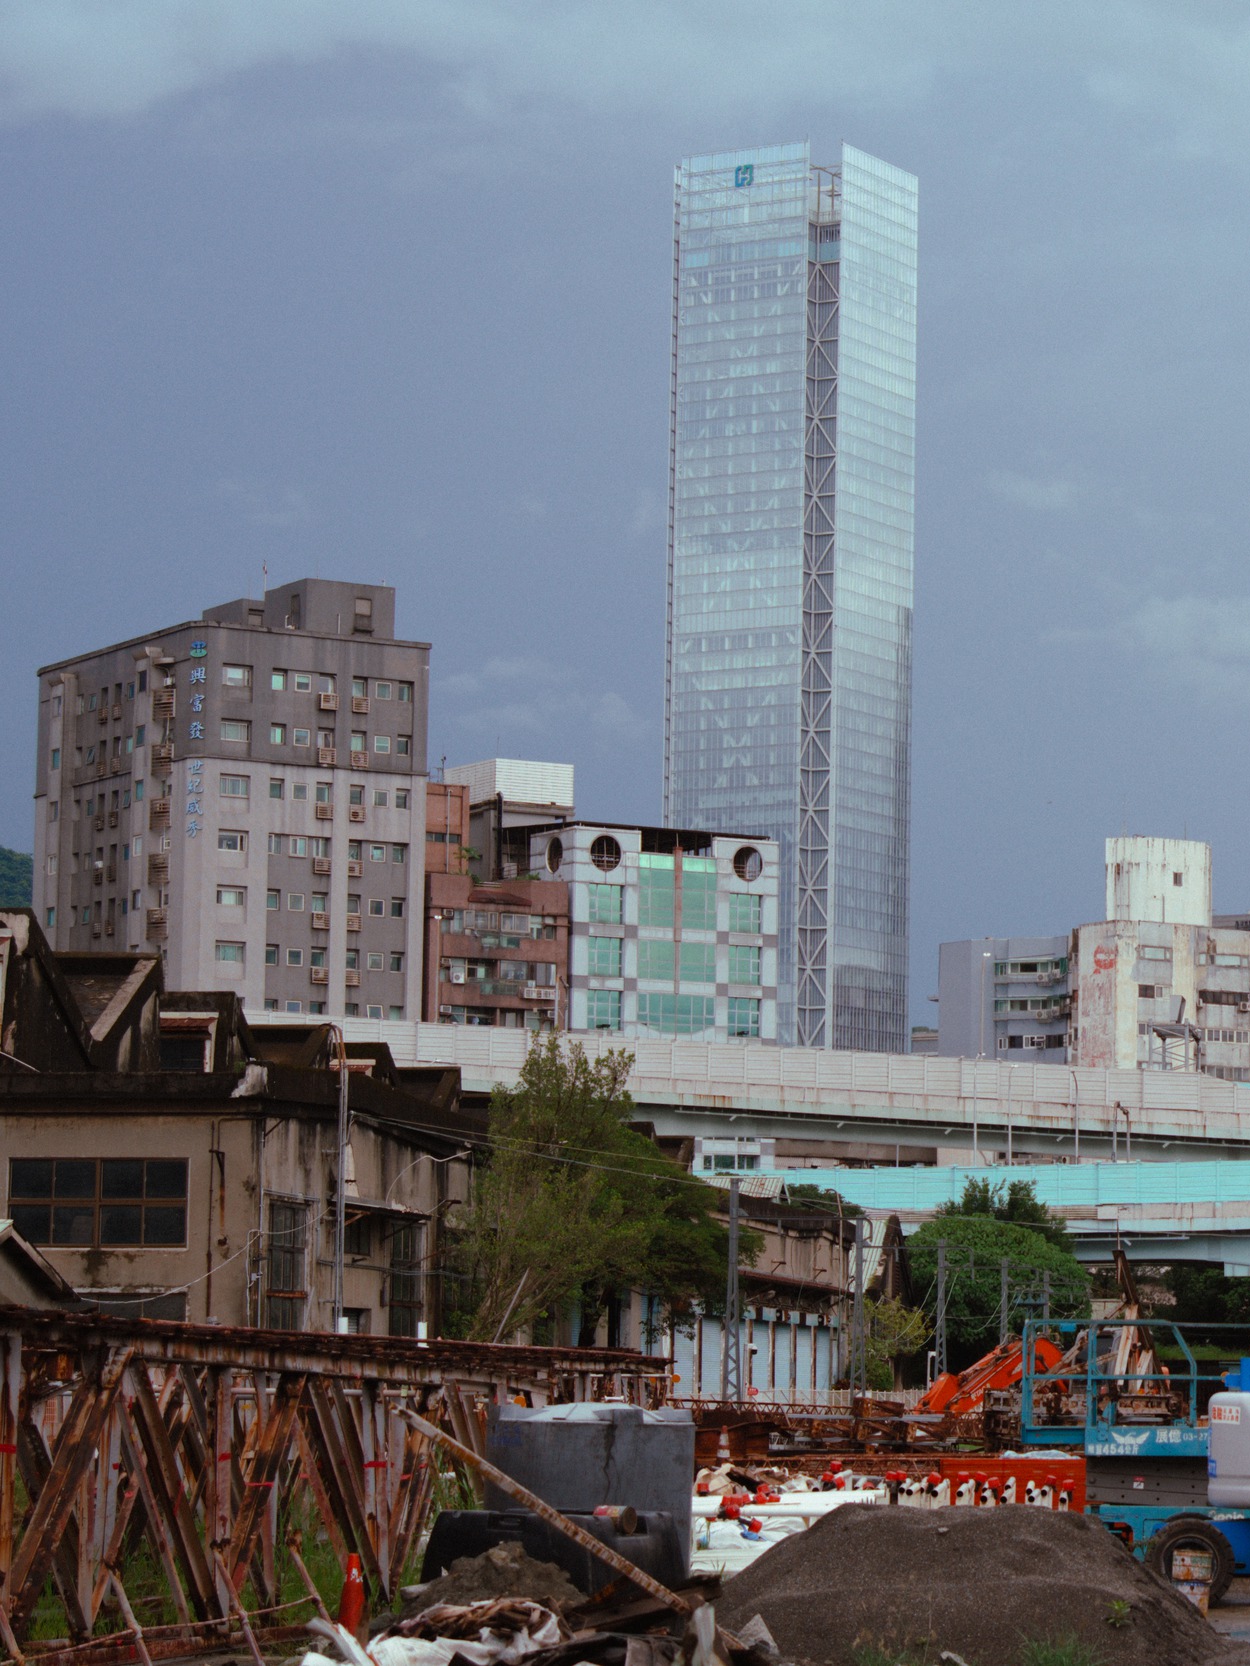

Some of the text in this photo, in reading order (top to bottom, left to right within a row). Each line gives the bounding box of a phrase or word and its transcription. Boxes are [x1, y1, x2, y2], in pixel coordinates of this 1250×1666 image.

[186, 666, 207, 839] 興富發 世紀威秀
